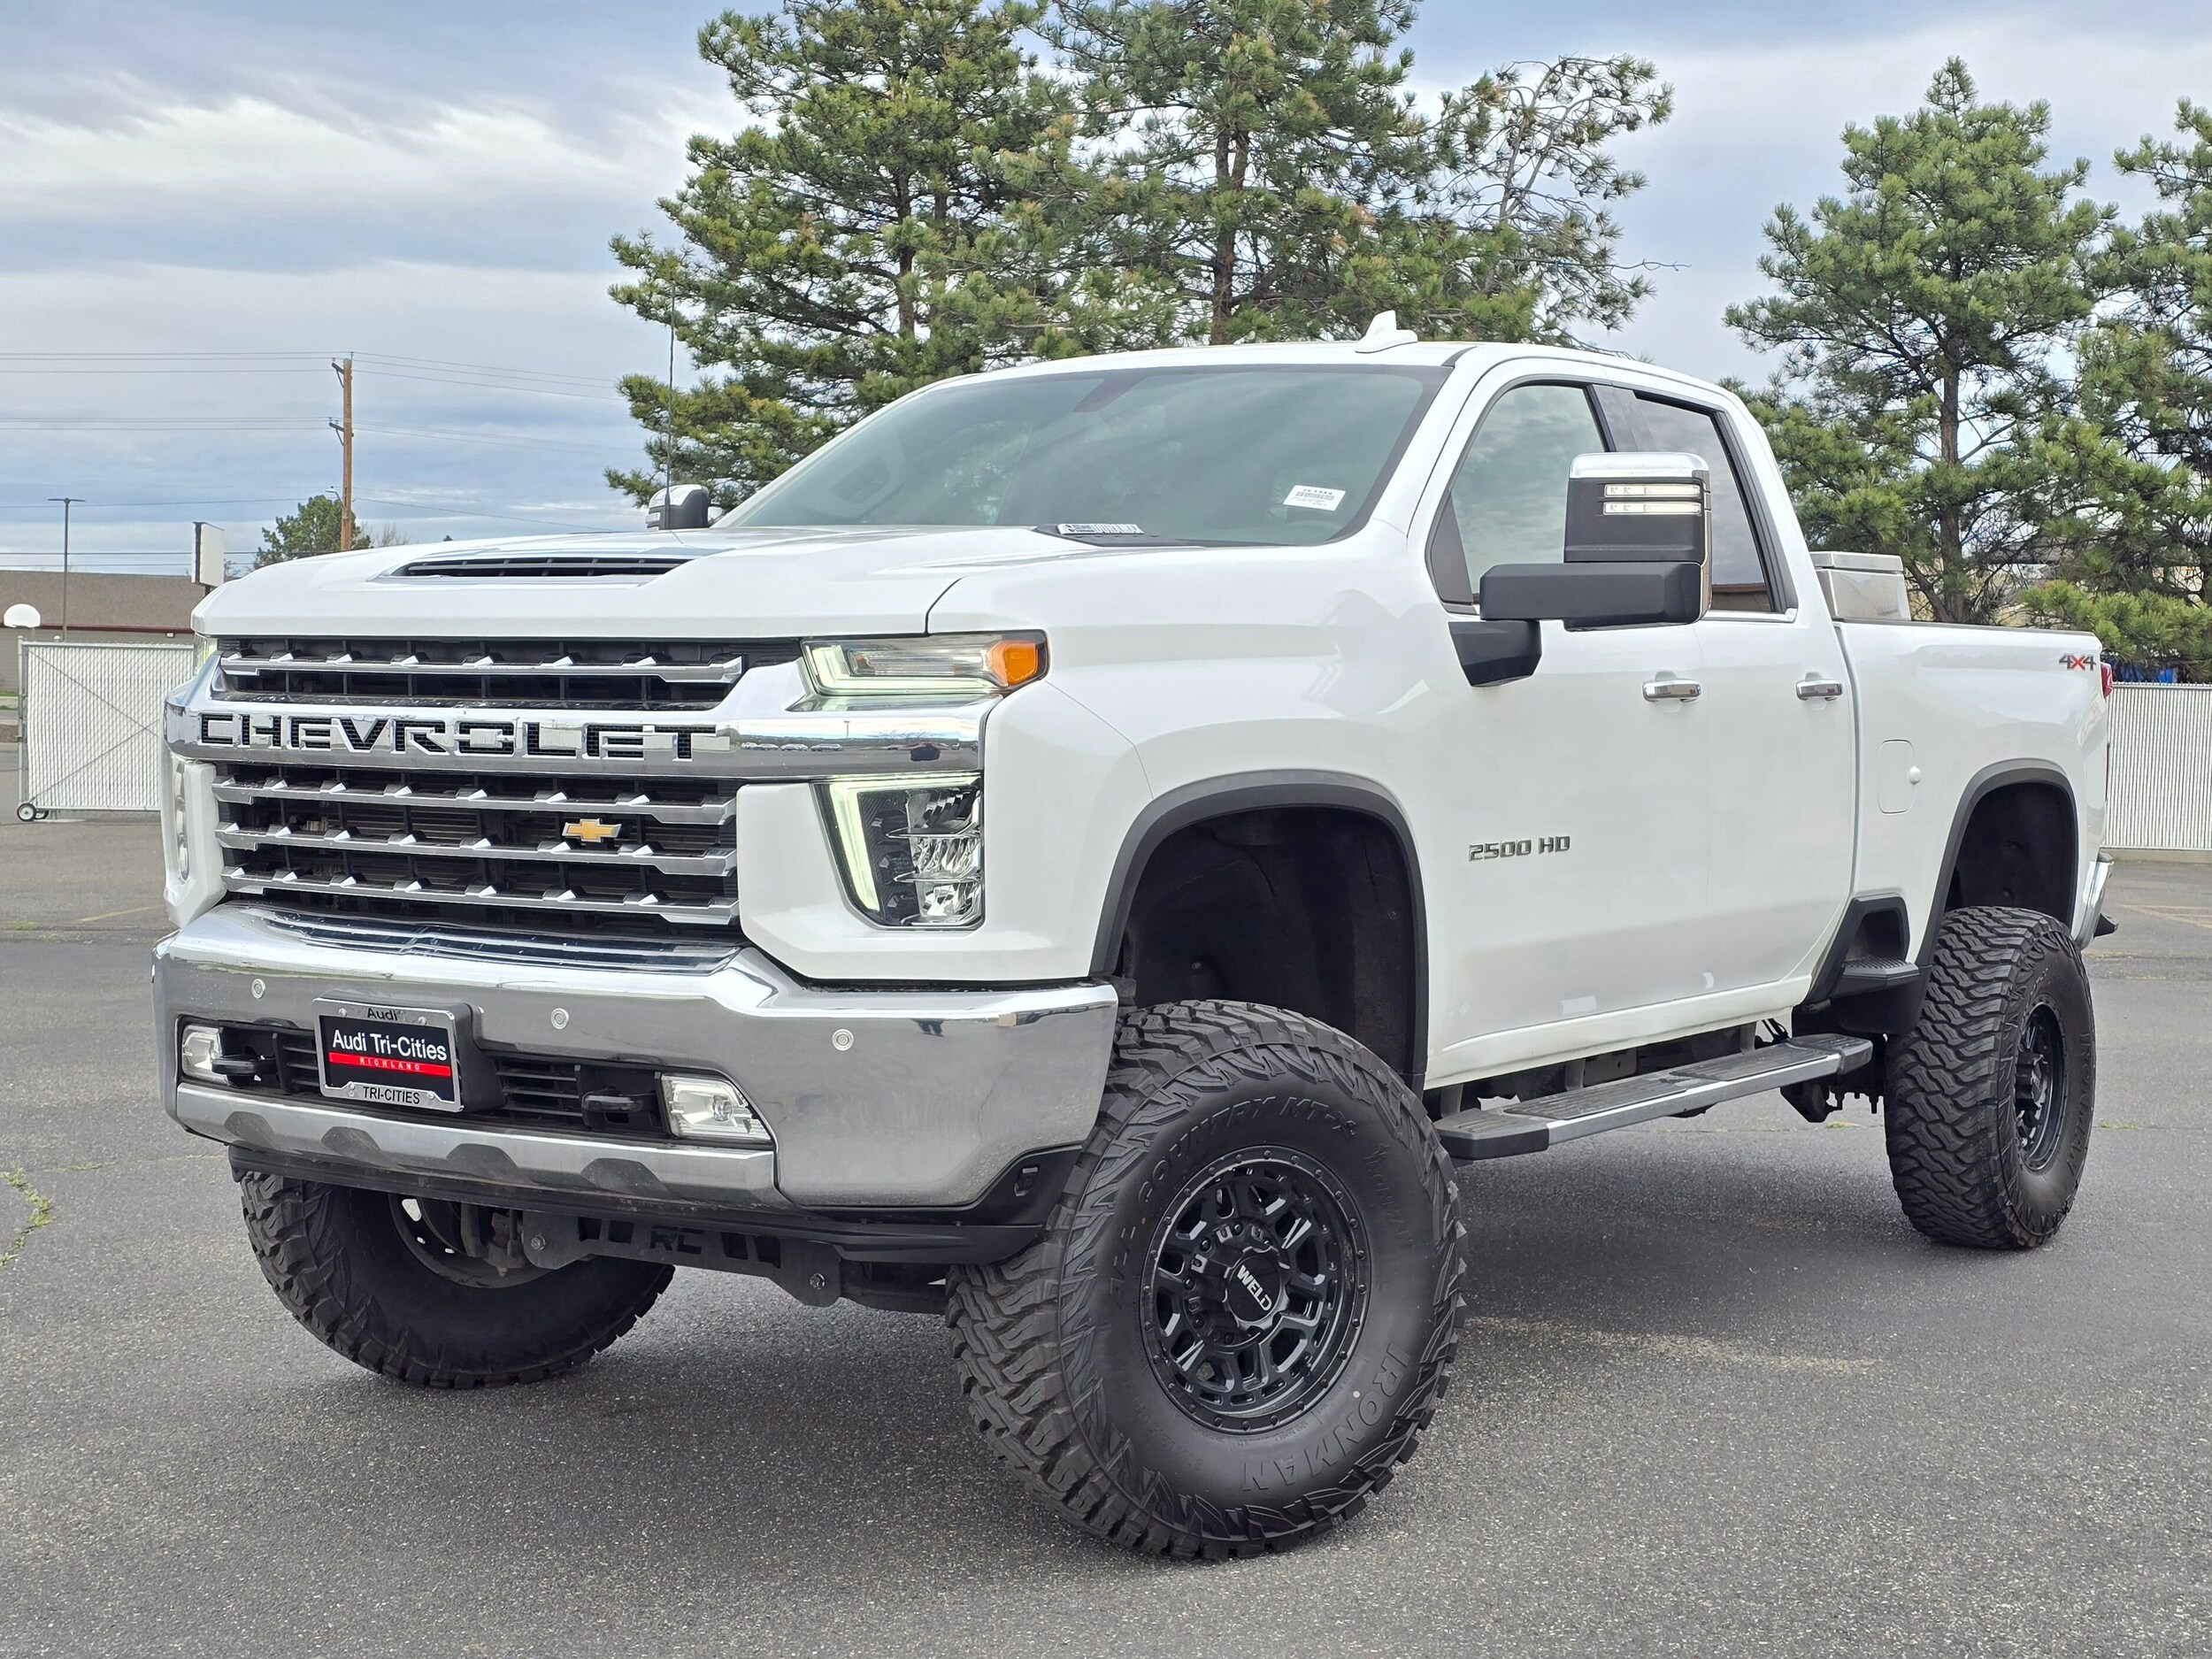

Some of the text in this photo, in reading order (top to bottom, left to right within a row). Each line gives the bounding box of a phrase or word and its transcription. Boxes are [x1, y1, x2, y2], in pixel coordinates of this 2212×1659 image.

[198, 711, 720, 761] CHEVROLET
[1468, 835, 1571, 862] 2500 HD
[366, 1007, 398, 1021] Audi
[332, 1029, 448, 1061] Audi Tri-Cities
[359, 1057, 421, 1071] RICHLAND
[362, 1086, 421, 1105] TRI-CITIES
[1236, 1263, 1272, 1311] WELD
[1240, 1342, 1411, 1492] IRONMAN
